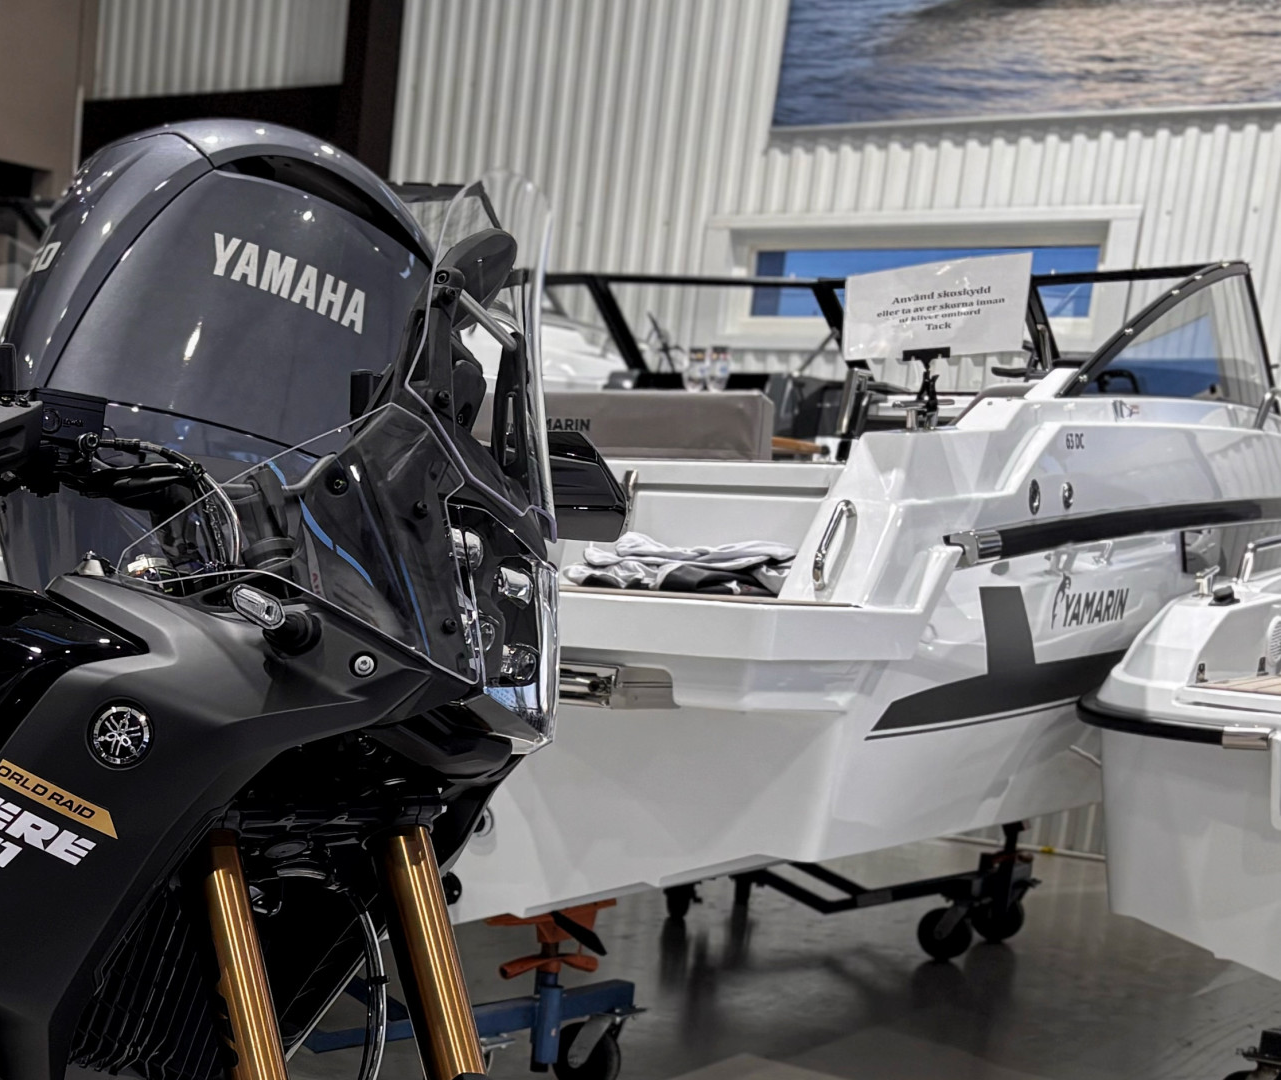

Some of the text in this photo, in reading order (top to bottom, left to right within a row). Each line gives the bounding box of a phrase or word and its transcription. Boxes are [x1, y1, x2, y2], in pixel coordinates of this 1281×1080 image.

[213, 232, 366, 335] YAMAHA
[891, 285, 992, 305] Använd skoskydd
[876, 309, 900, 318] eller
[901, 307, 911, 315] ta
[926, 304, 938, 312] er
[976, 297, 1006, 306] innan
[925, 321, 952, 331] Tack
[1075, 432, 1085, 450] DC
[1062, 587, 1130, 628] YAMARIN
[48, 791, 96, 820] RAID
